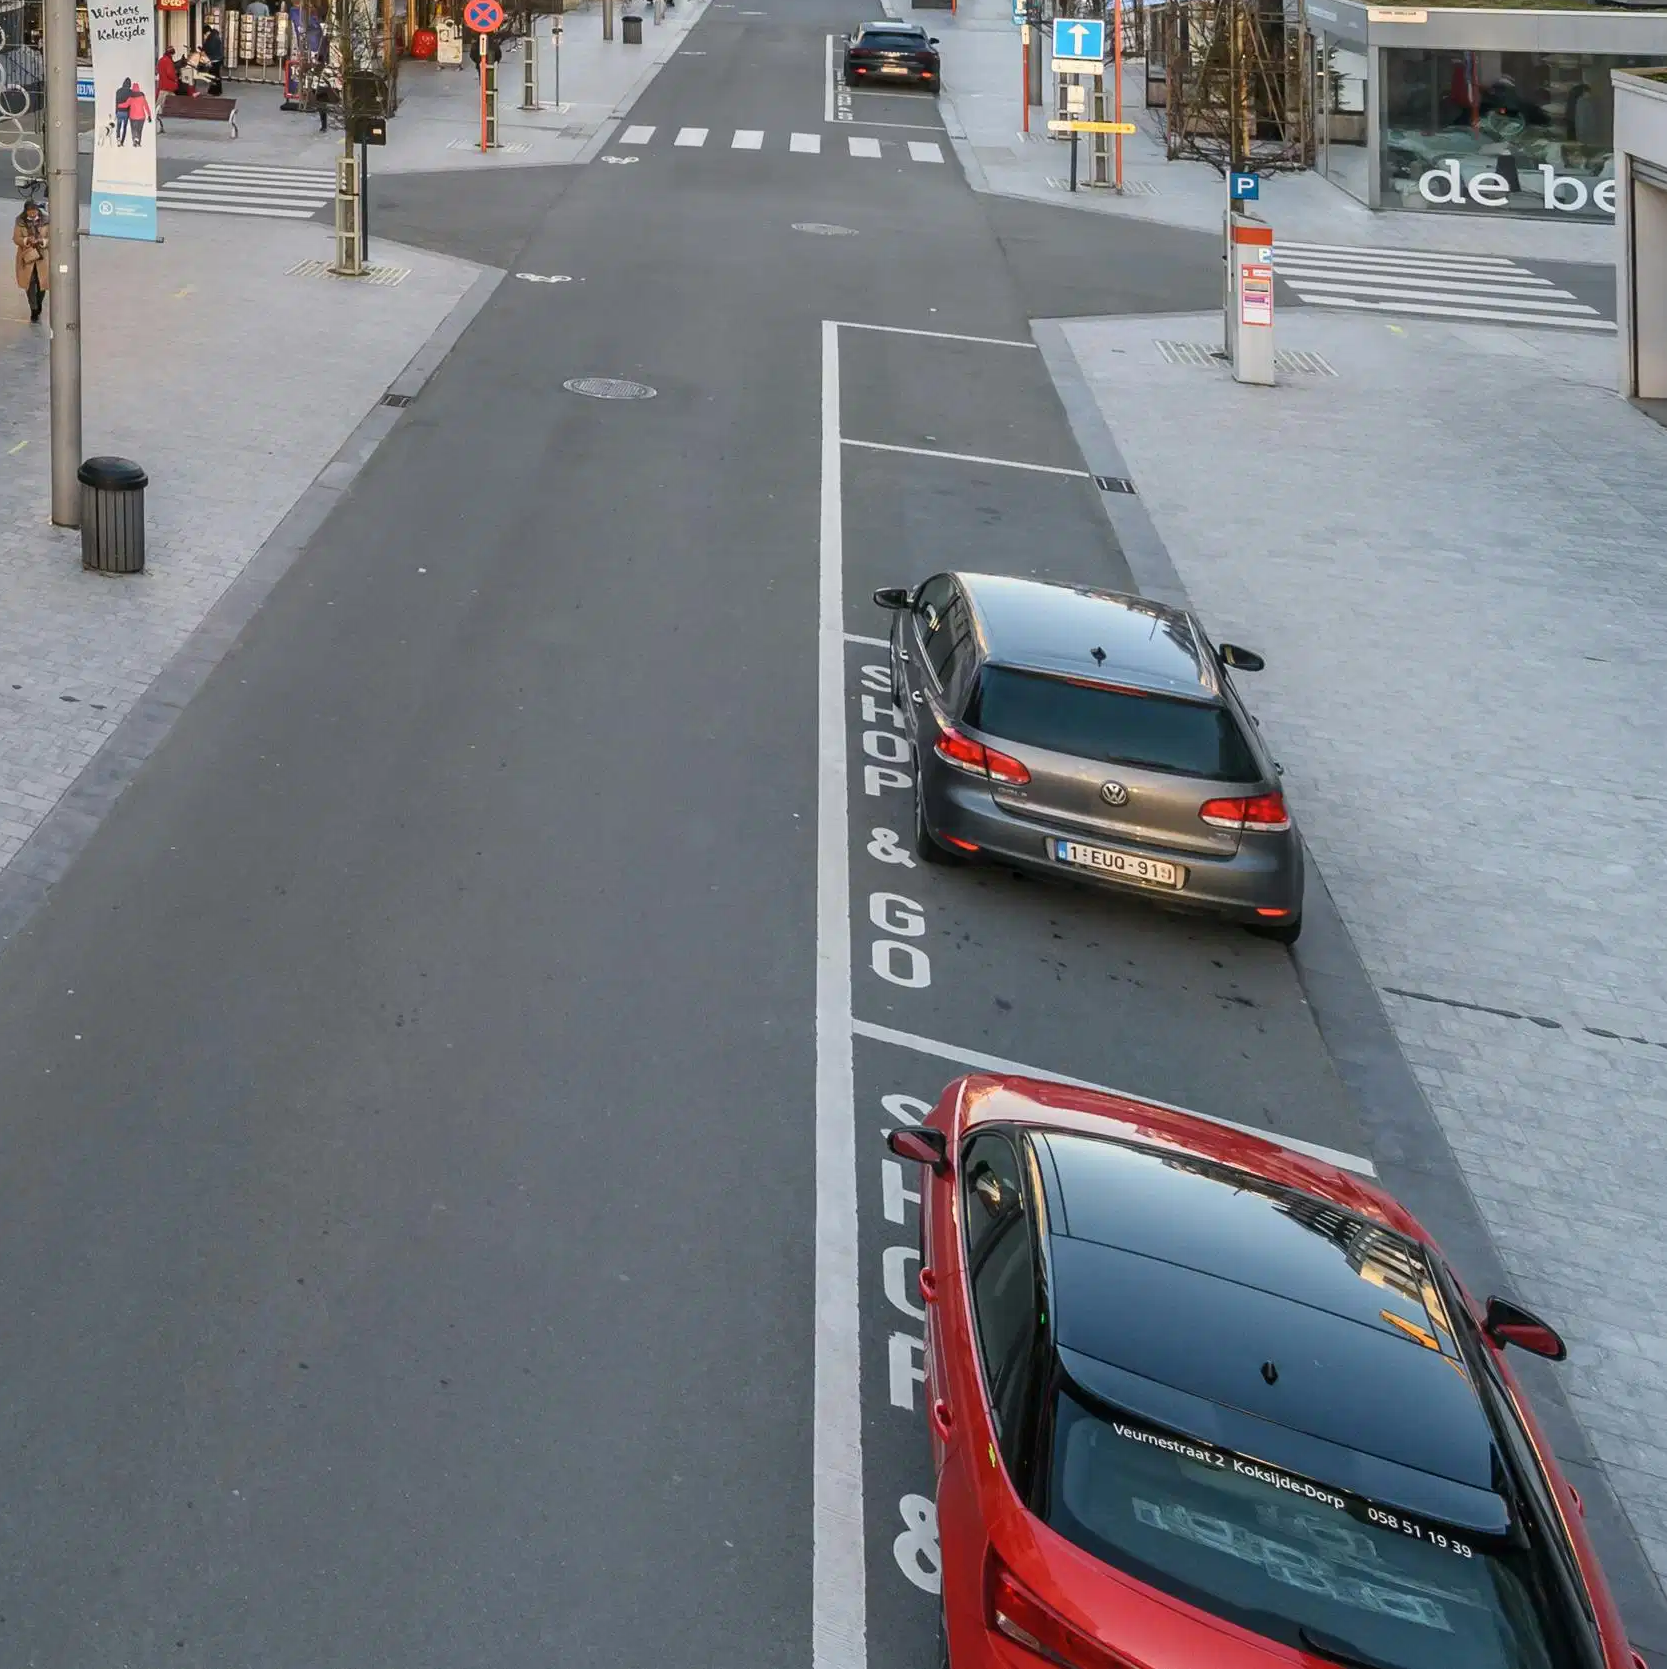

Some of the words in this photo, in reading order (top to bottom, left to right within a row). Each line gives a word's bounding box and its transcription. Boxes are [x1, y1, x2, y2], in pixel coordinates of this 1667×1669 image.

[91, 5, 139, 19] Winters
[115, 15, 149, 27] warm
[97, 25, 146, 41] Koksijde
[1237, 177, 1255, 194] P
[1418, 158, 1510, 207] de
[869, 891, 932, 989] GO
[1113, 1422, 1212, 1464] Veurnestraat
[1214, 1453, 1226, 1468] 2
[1233, 1459, 1346, 1510] Koksijde-Dorp
[1367, 1506, 1399, 1530] 058
[1401, 1521, 1422, 1539] 51
[1427, 1530, 1447, 1549] 19
[1451, 1540, 1473, 1560] 39
